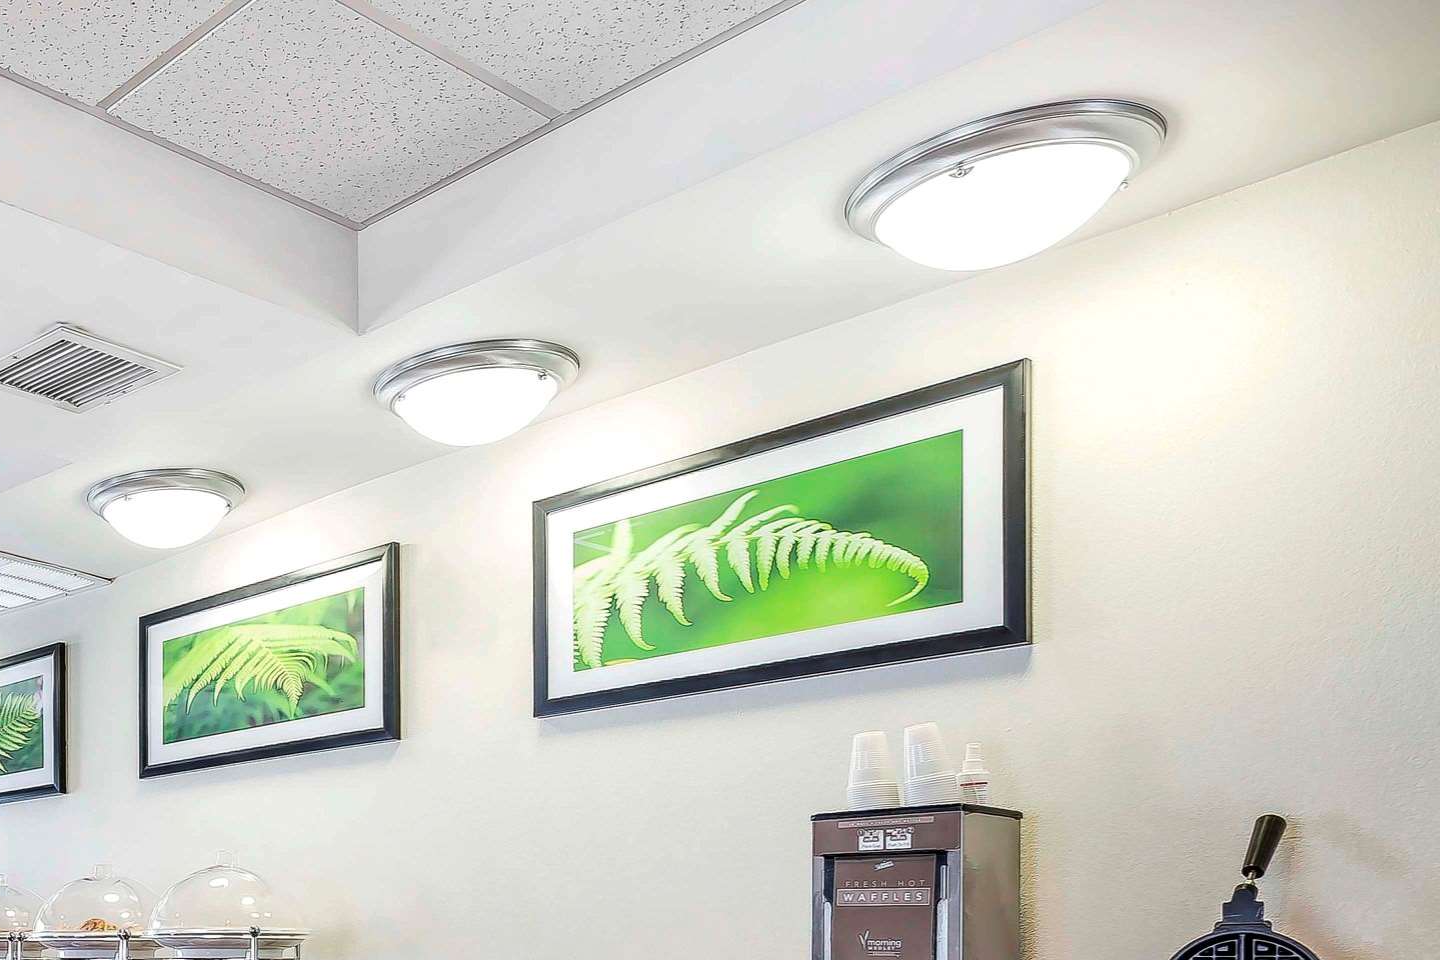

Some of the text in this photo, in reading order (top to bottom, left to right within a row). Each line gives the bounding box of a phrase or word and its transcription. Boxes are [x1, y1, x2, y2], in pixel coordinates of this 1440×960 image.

[897, 879, 926, 887] HOT
[843, 891, 923, 902] WAFFLES
[867, 939, 902, 949] morning
